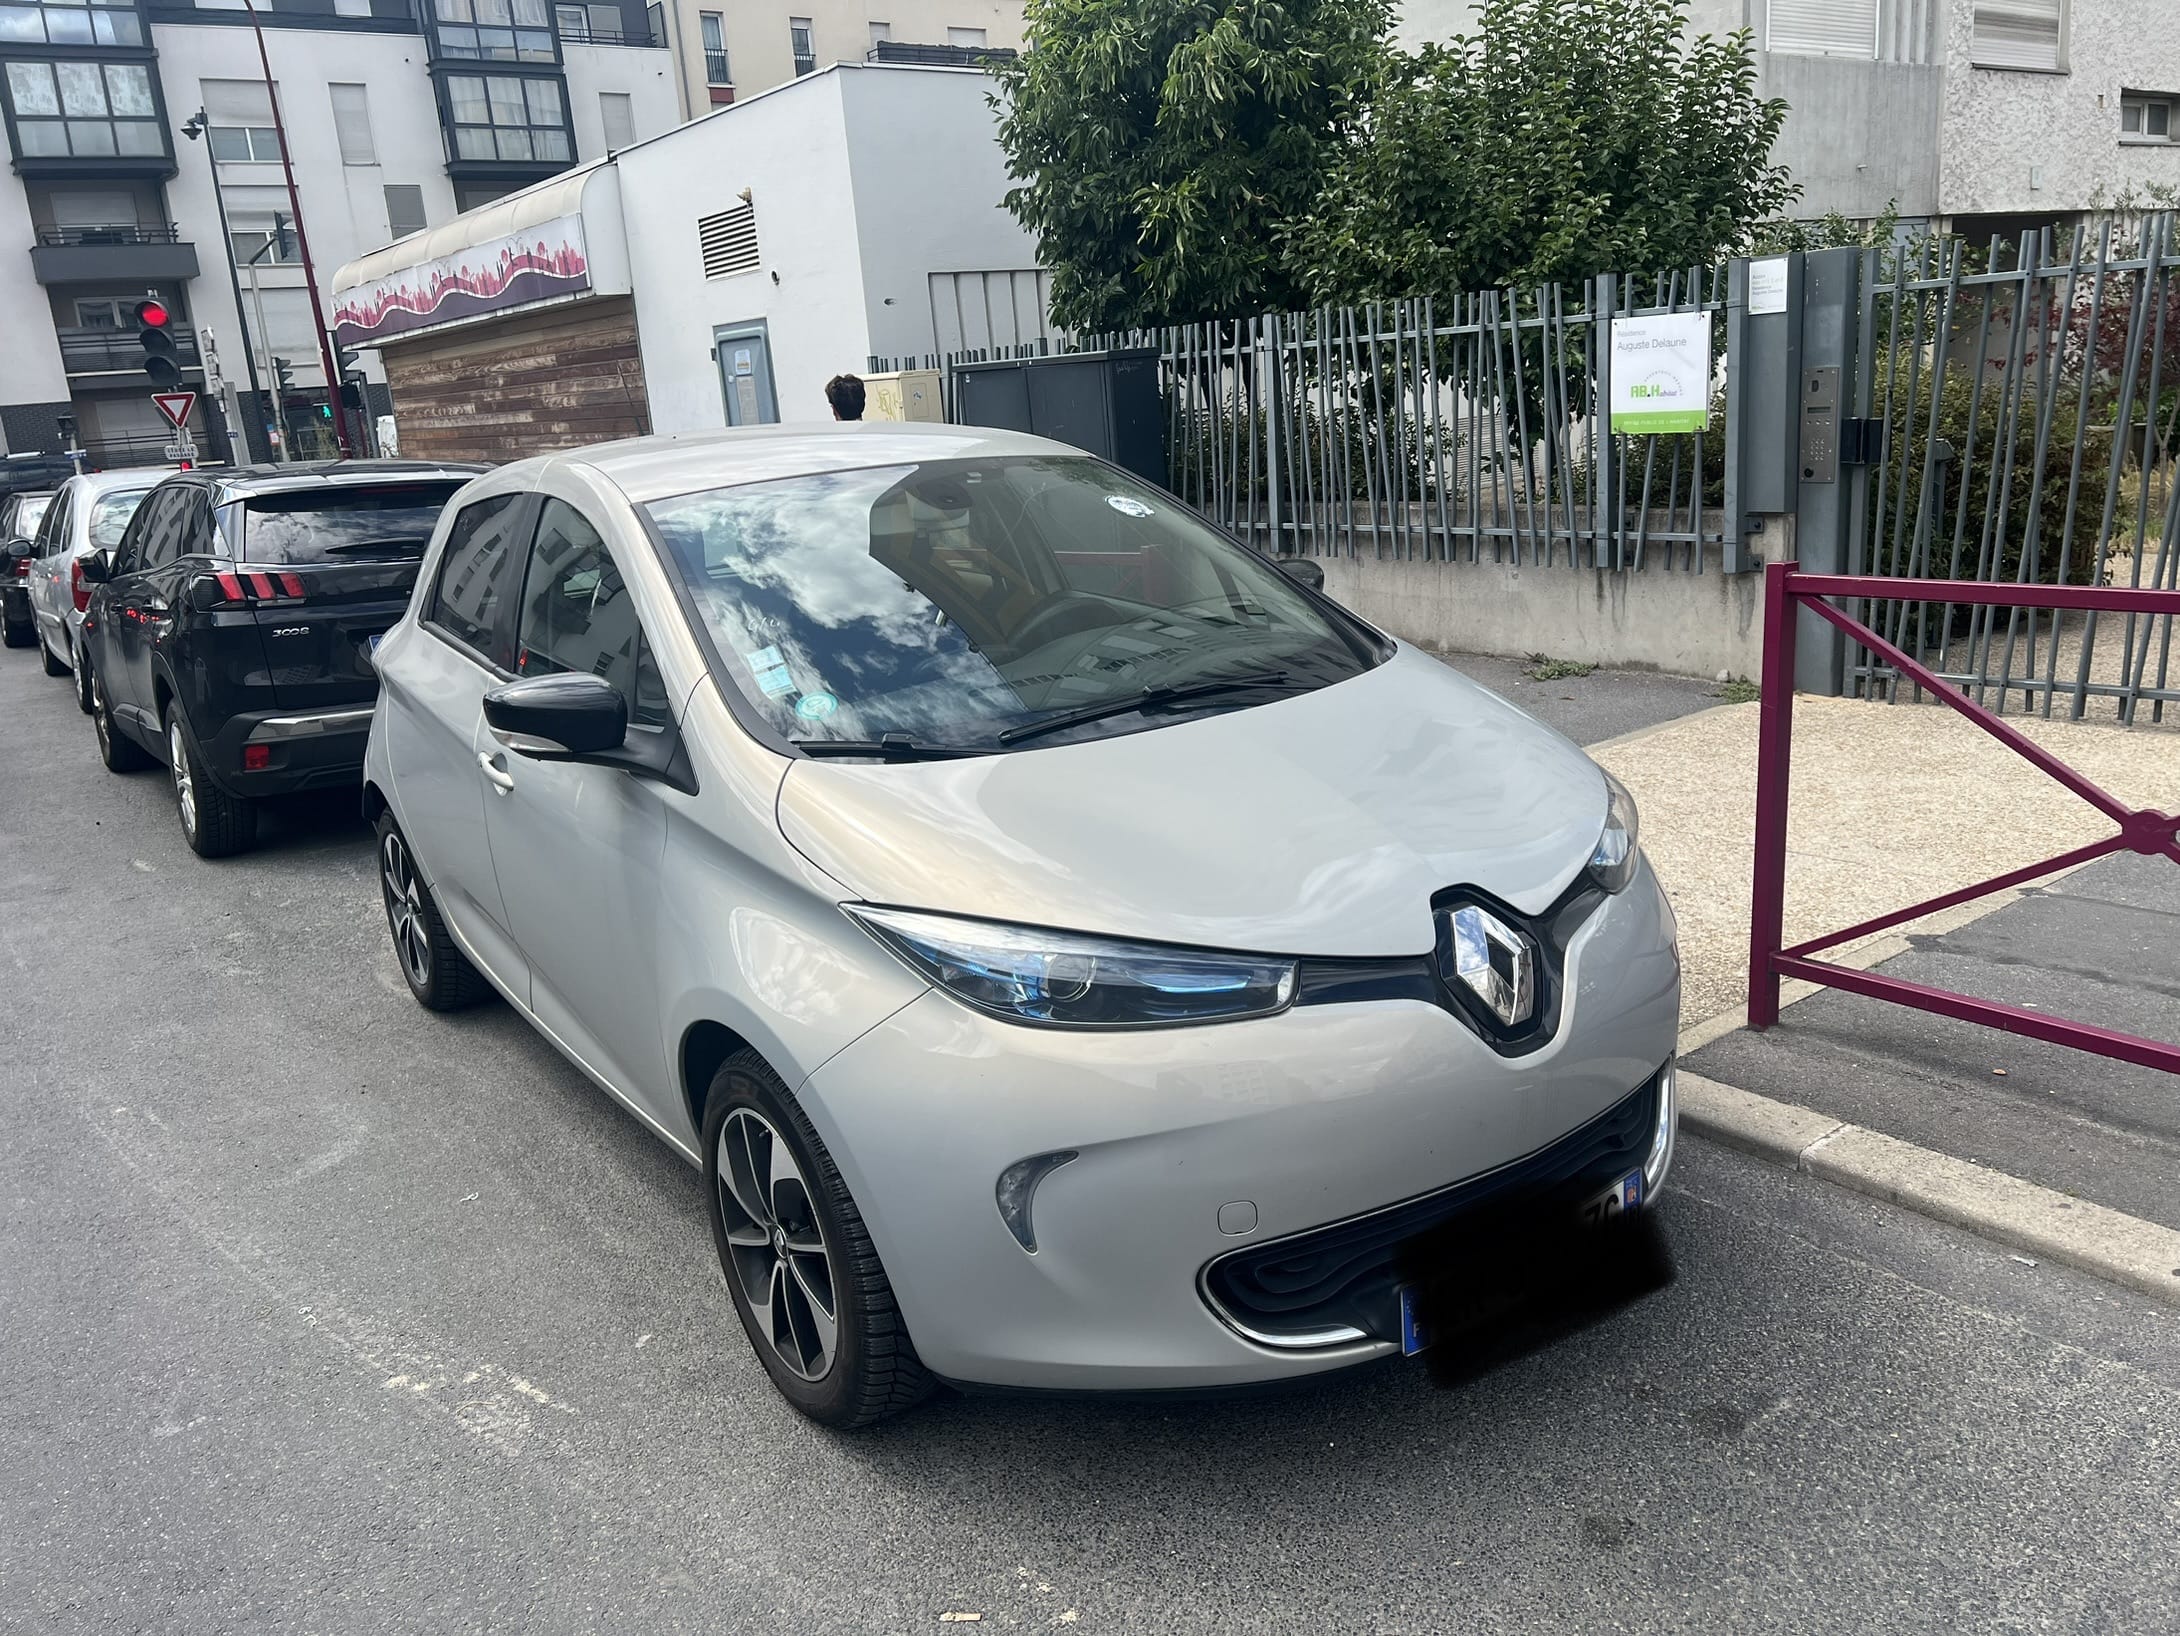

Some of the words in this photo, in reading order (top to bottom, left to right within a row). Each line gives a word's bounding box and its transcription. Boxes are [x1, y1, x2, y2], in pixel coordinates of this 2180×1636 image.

[1616, 340, 1650, 352] Auguste
[1651, 337, 1687, 349] Delaune
[272, 626, 310, 638] 3008
[1413, 1322, 1421, 1338] F
